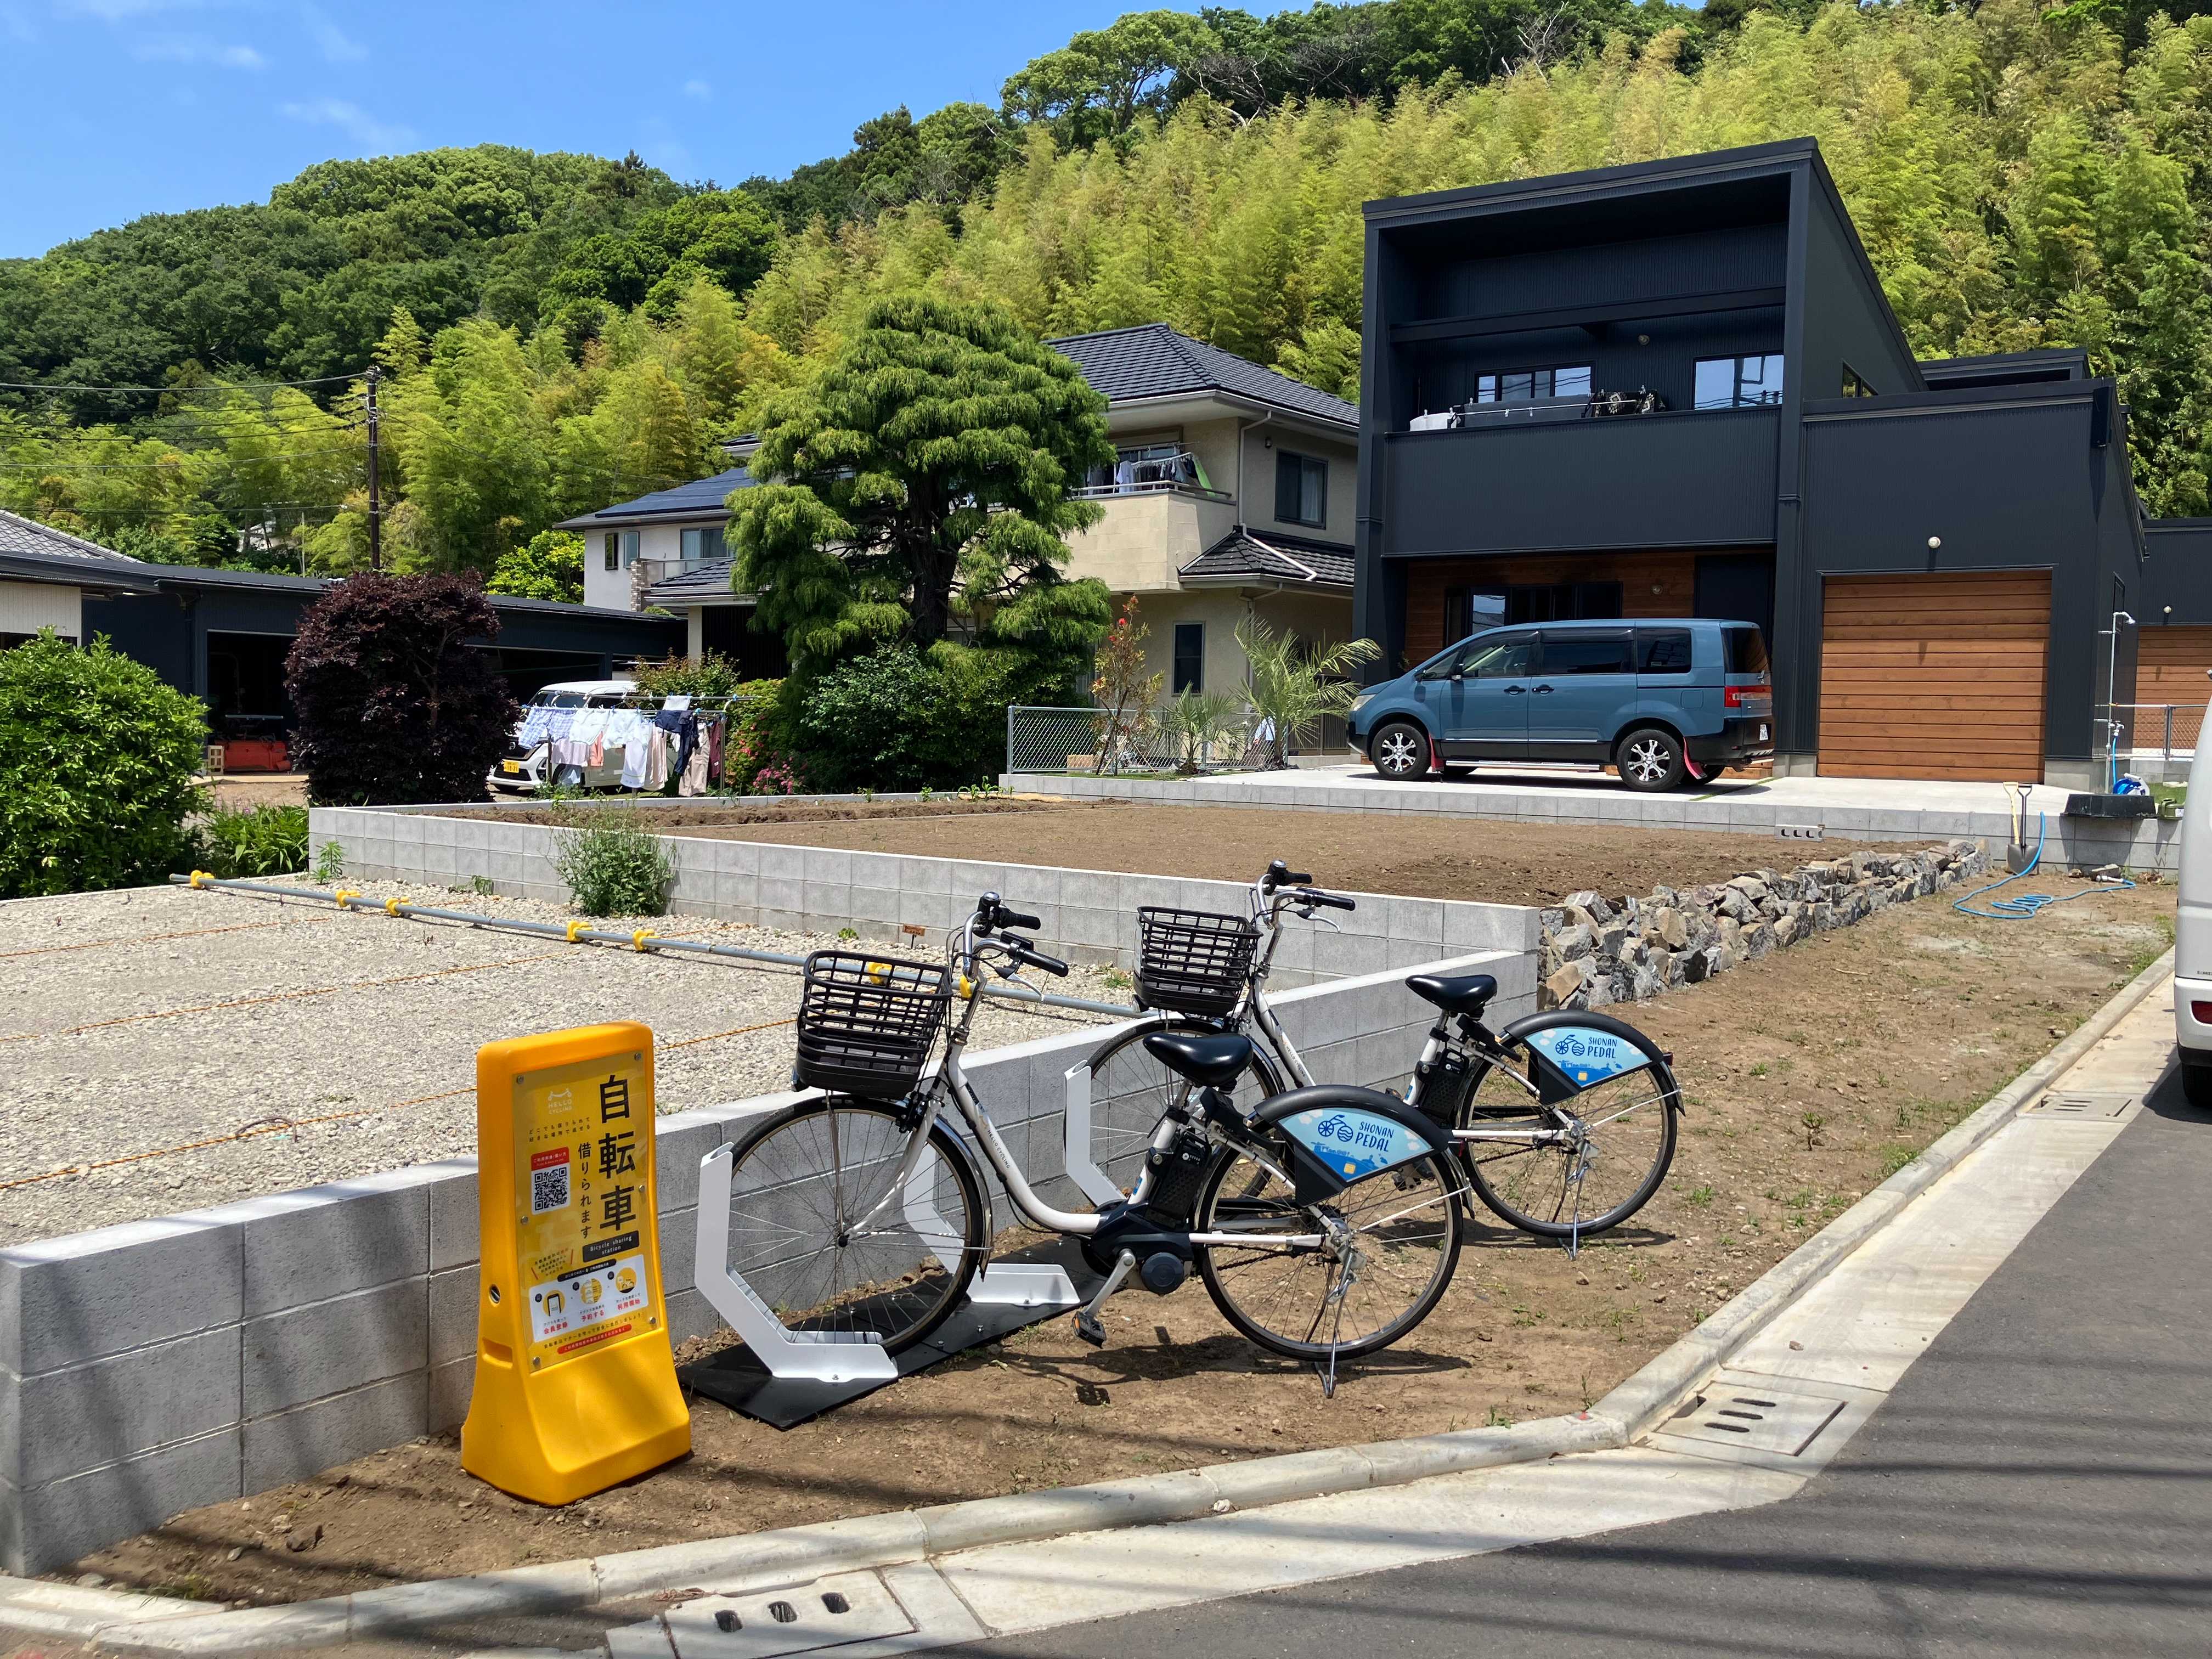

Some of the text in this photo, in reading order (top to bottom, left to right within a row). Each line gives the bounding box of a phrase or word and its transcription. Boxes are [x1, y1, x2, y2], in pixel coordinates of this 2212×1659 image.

[1588, 1037, 1617, 1047] SHONAN
[1587, 1046, 1616, 1058] PEDAL
[549, 1099, 572, 1108] HELLO
[549, 1106, 572, 1115] CYCLING
[1359, 1121, 1394, 1138] SHONAN
[987, 1129, 1010, 1169] HELLO CYCLING
[1355, 1132, 1389, 1152] PEDAL
[598, 1075, 636, 1231] 自転車
[578, 1142, 592, 1239] 借りられます
[590, 1235, 632, 1251] Bicycle sharing
[602, 1245, 621, 1255] station
[581, 1310, 604, 1322] 予約する
